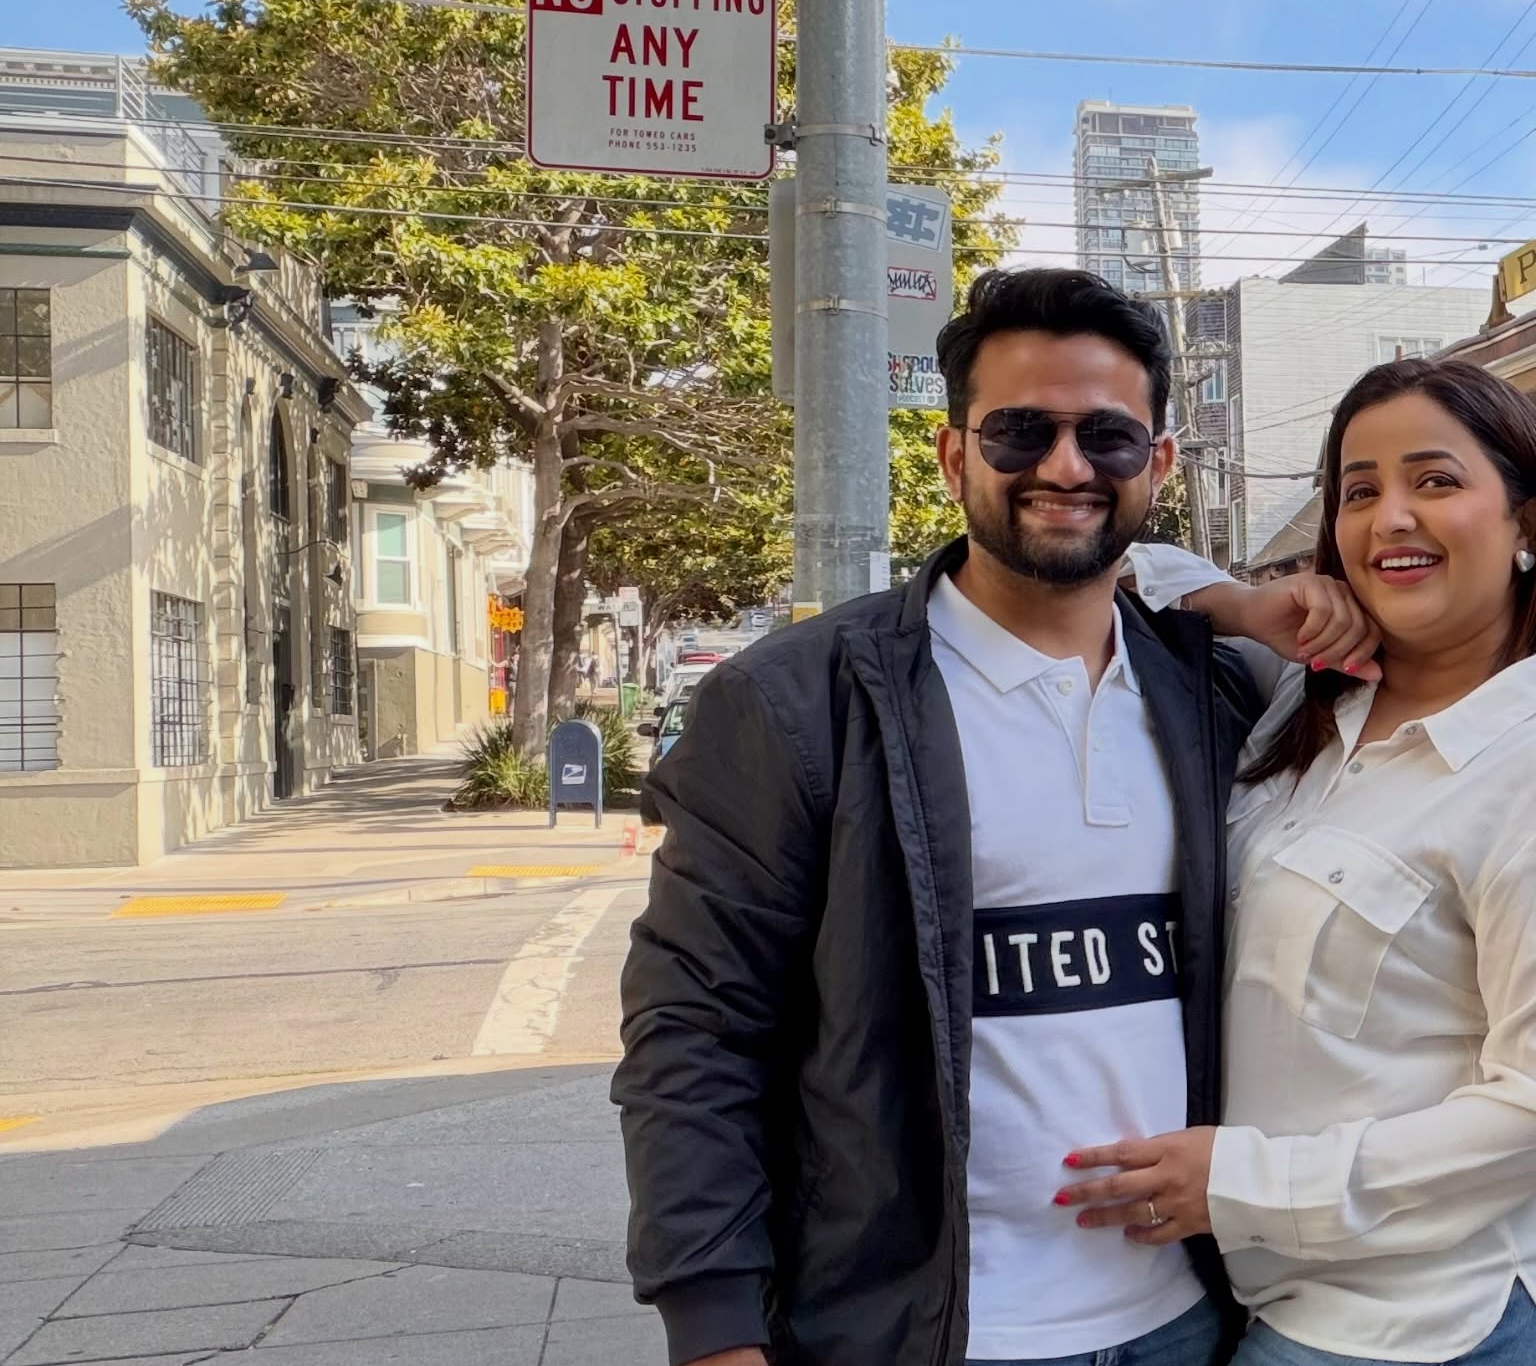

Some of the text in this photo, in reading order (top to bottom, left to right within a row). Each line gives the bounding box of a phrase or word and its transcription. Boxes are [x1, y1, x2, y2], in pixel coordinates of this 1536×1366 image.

[609, 23, 699, 68] ANY
[602, 75, 704, 122] TIME
[608, 139, 697, 153] PHONE 553-1235
[610, 127, 696, 141] FOR TOWED CARS
